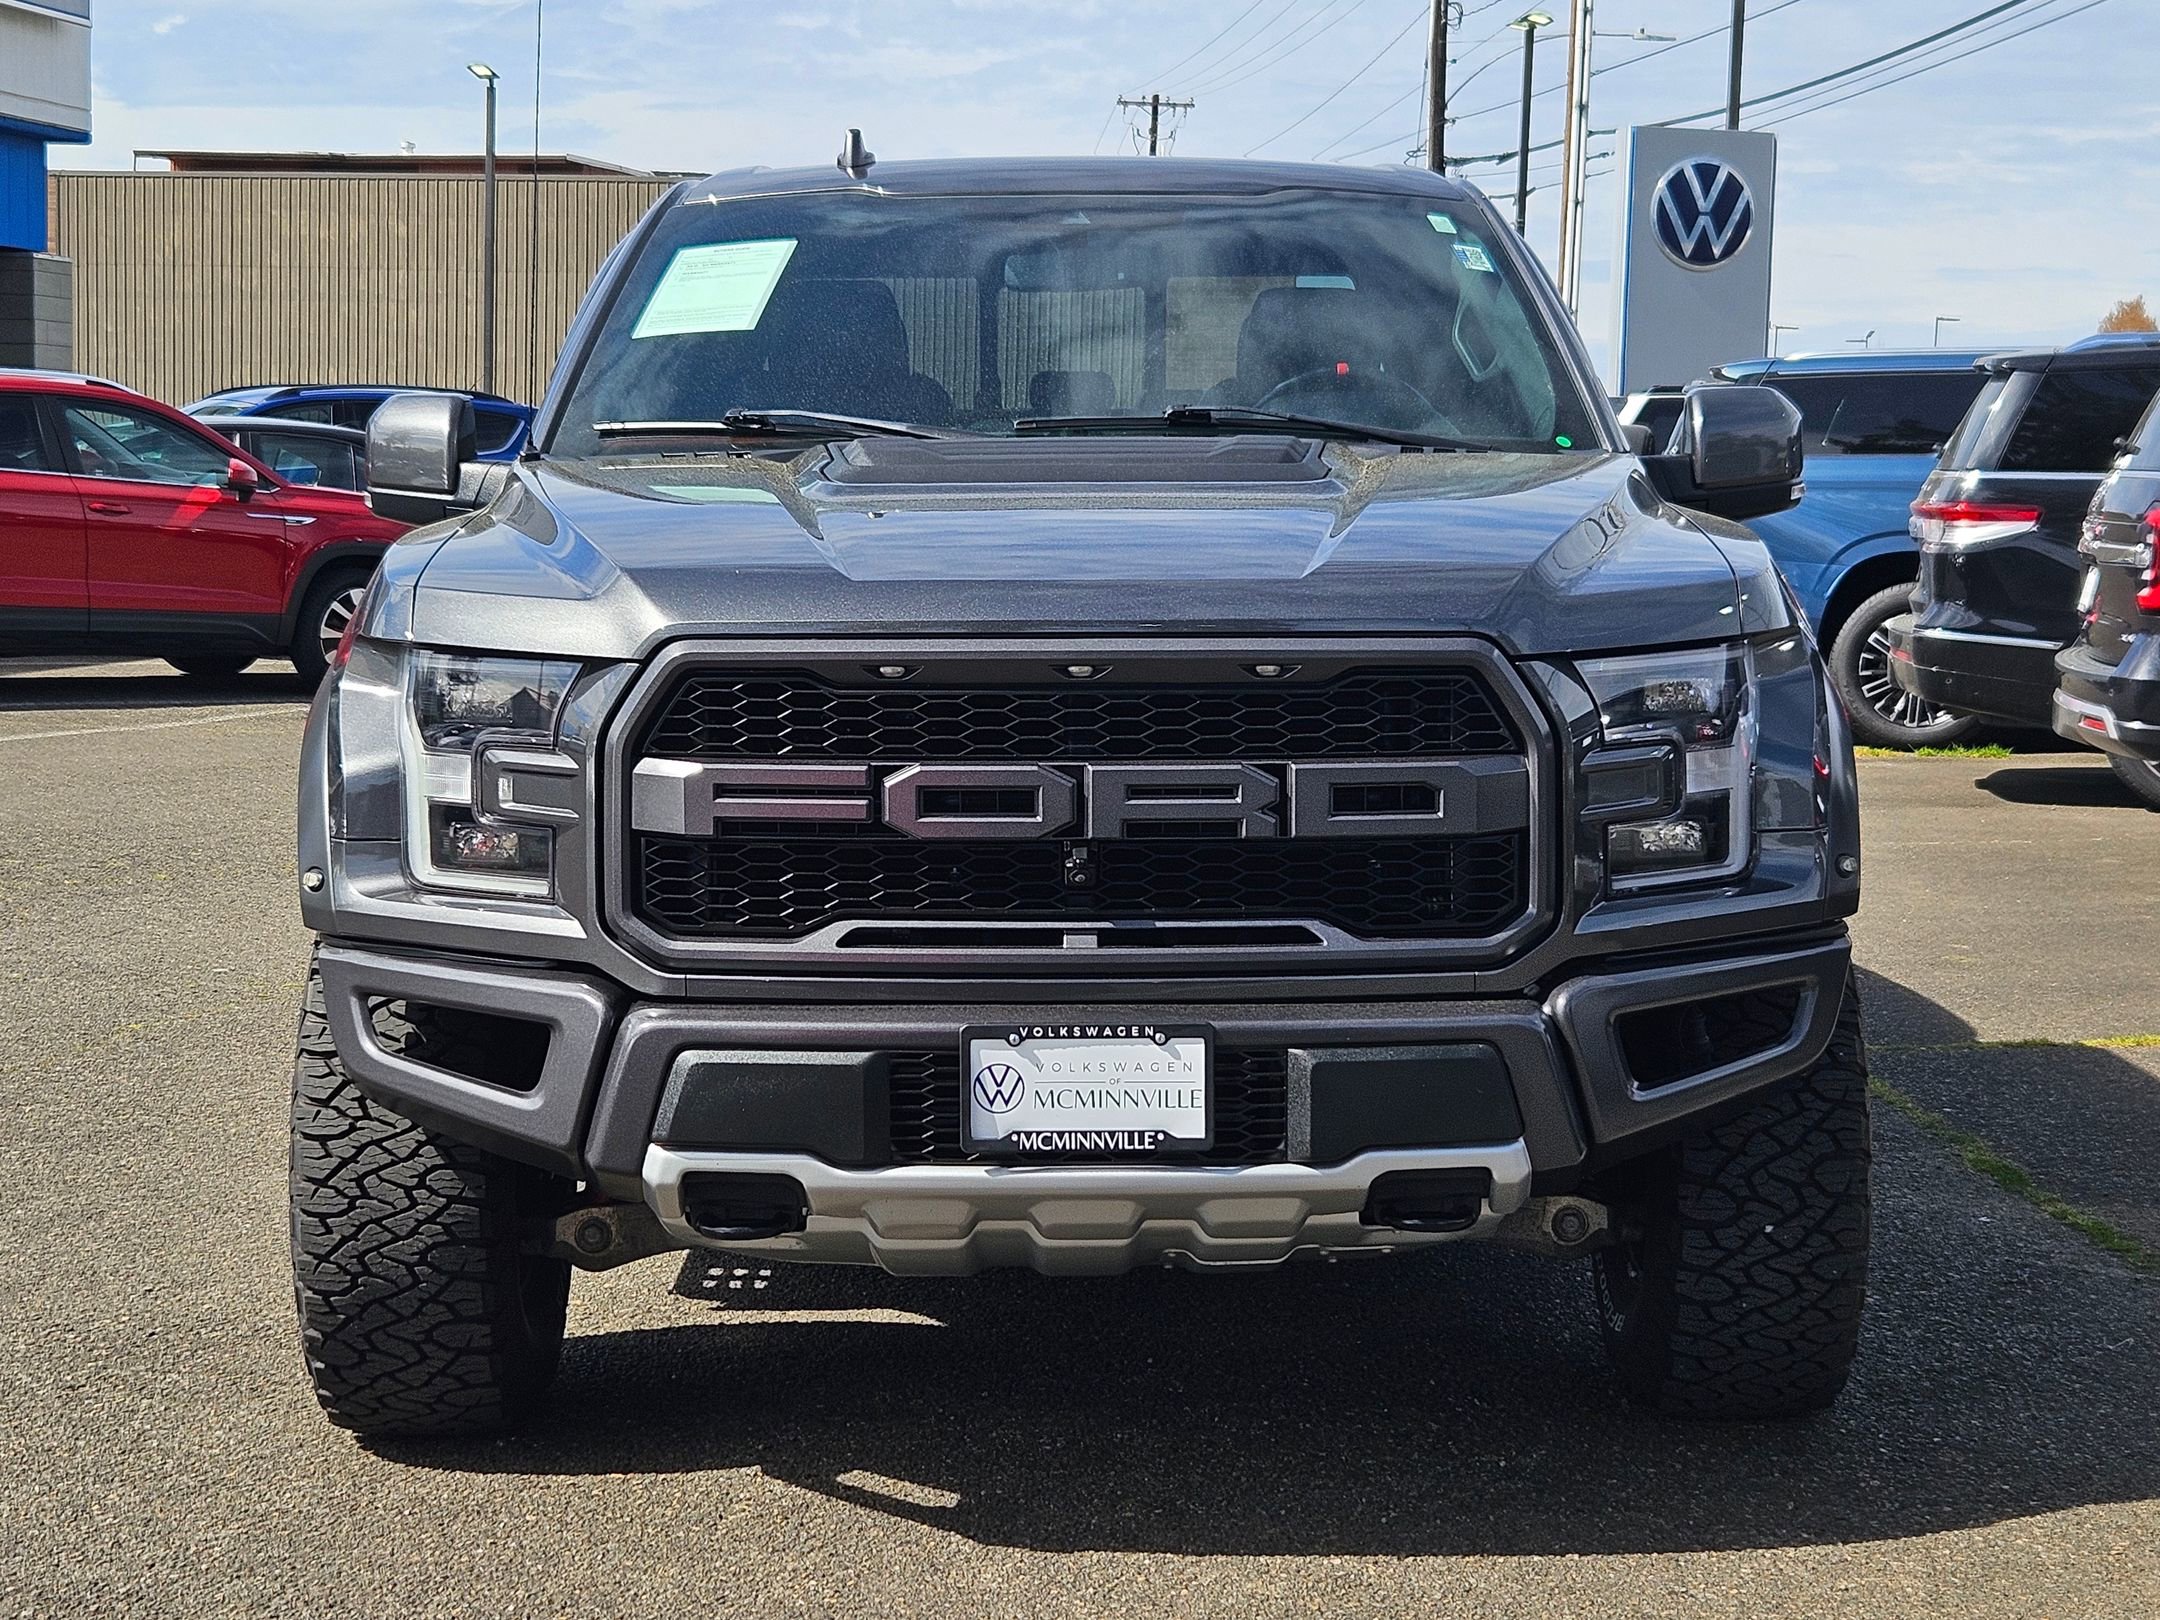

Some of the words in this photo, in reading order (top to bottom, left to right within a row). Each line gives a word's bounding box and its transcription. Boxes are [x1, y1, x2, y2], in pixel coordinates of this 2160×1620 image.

[1656, 161, 1754, 264] VW
[633, 757, 1520, 838] FORD
[1018, 1025, 1155, 1038] VOLKSWAGEN
[1034, 1061, 1193, 1073] VOLKSWAGEN
[1108, 1077, 1121, 1086] OF
[1033, 1088, 1203, 1109] MCMINNVILLE
[1018, 1131, 1156, 1150] MCMINNVILLE
